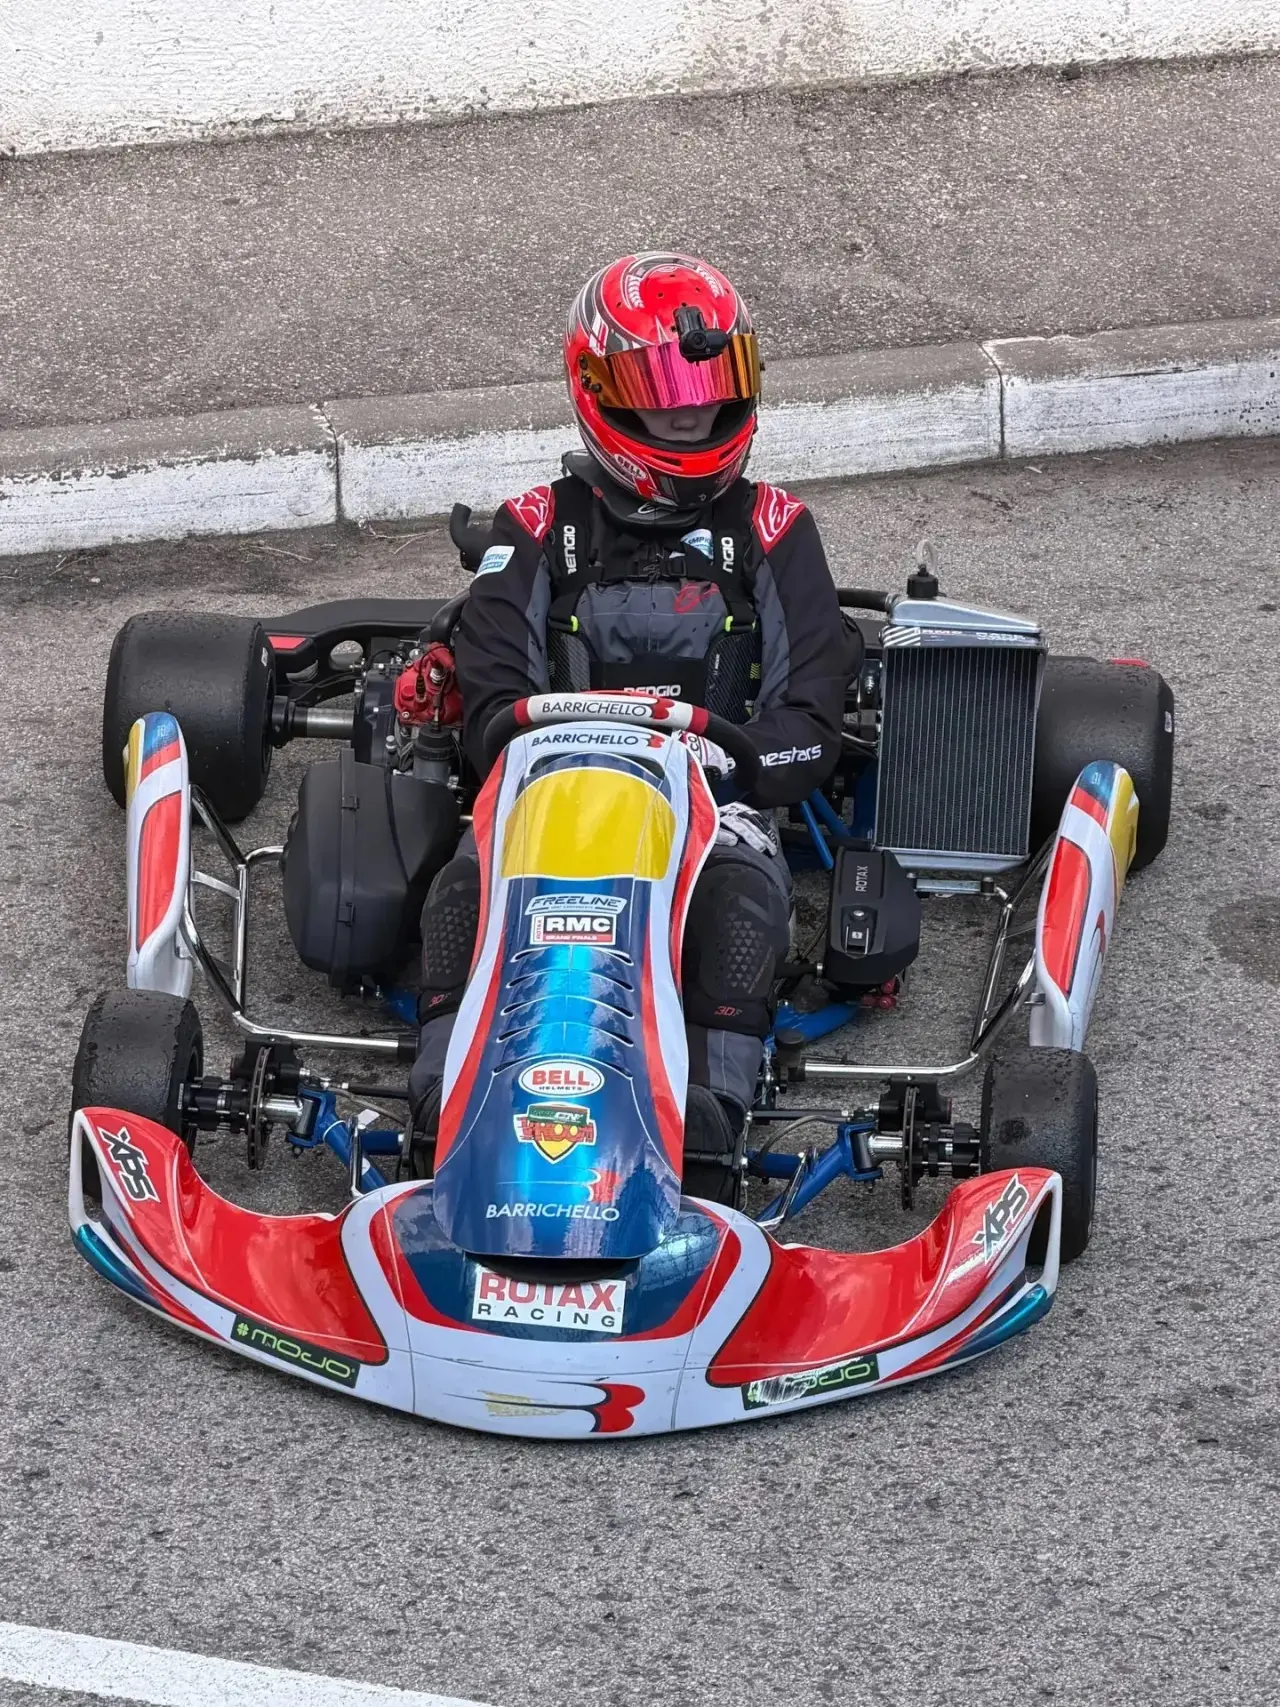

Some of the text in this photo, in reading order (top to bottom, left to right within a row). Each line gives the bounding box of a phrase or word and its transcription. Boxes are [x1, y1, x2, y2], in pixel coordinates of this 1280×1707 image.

[542, 701, 647, 717] BARRICHELLO
[531, 733, 639, 747] BARRICHELLO
[855, 865, 869, 892] ROTAX
[532, 895, 622, 908] FREELINE
[546, 916, 611, 932] RMC
[532, 1070, 590, 1087] BELL
[97, 1127, 160, 1202] XPS
[485, 1202, 620, 1222] BARRICHELLO
[972, 1173, 1029, 1265] XPS
[477, 1302, 616, 1328] RACING
